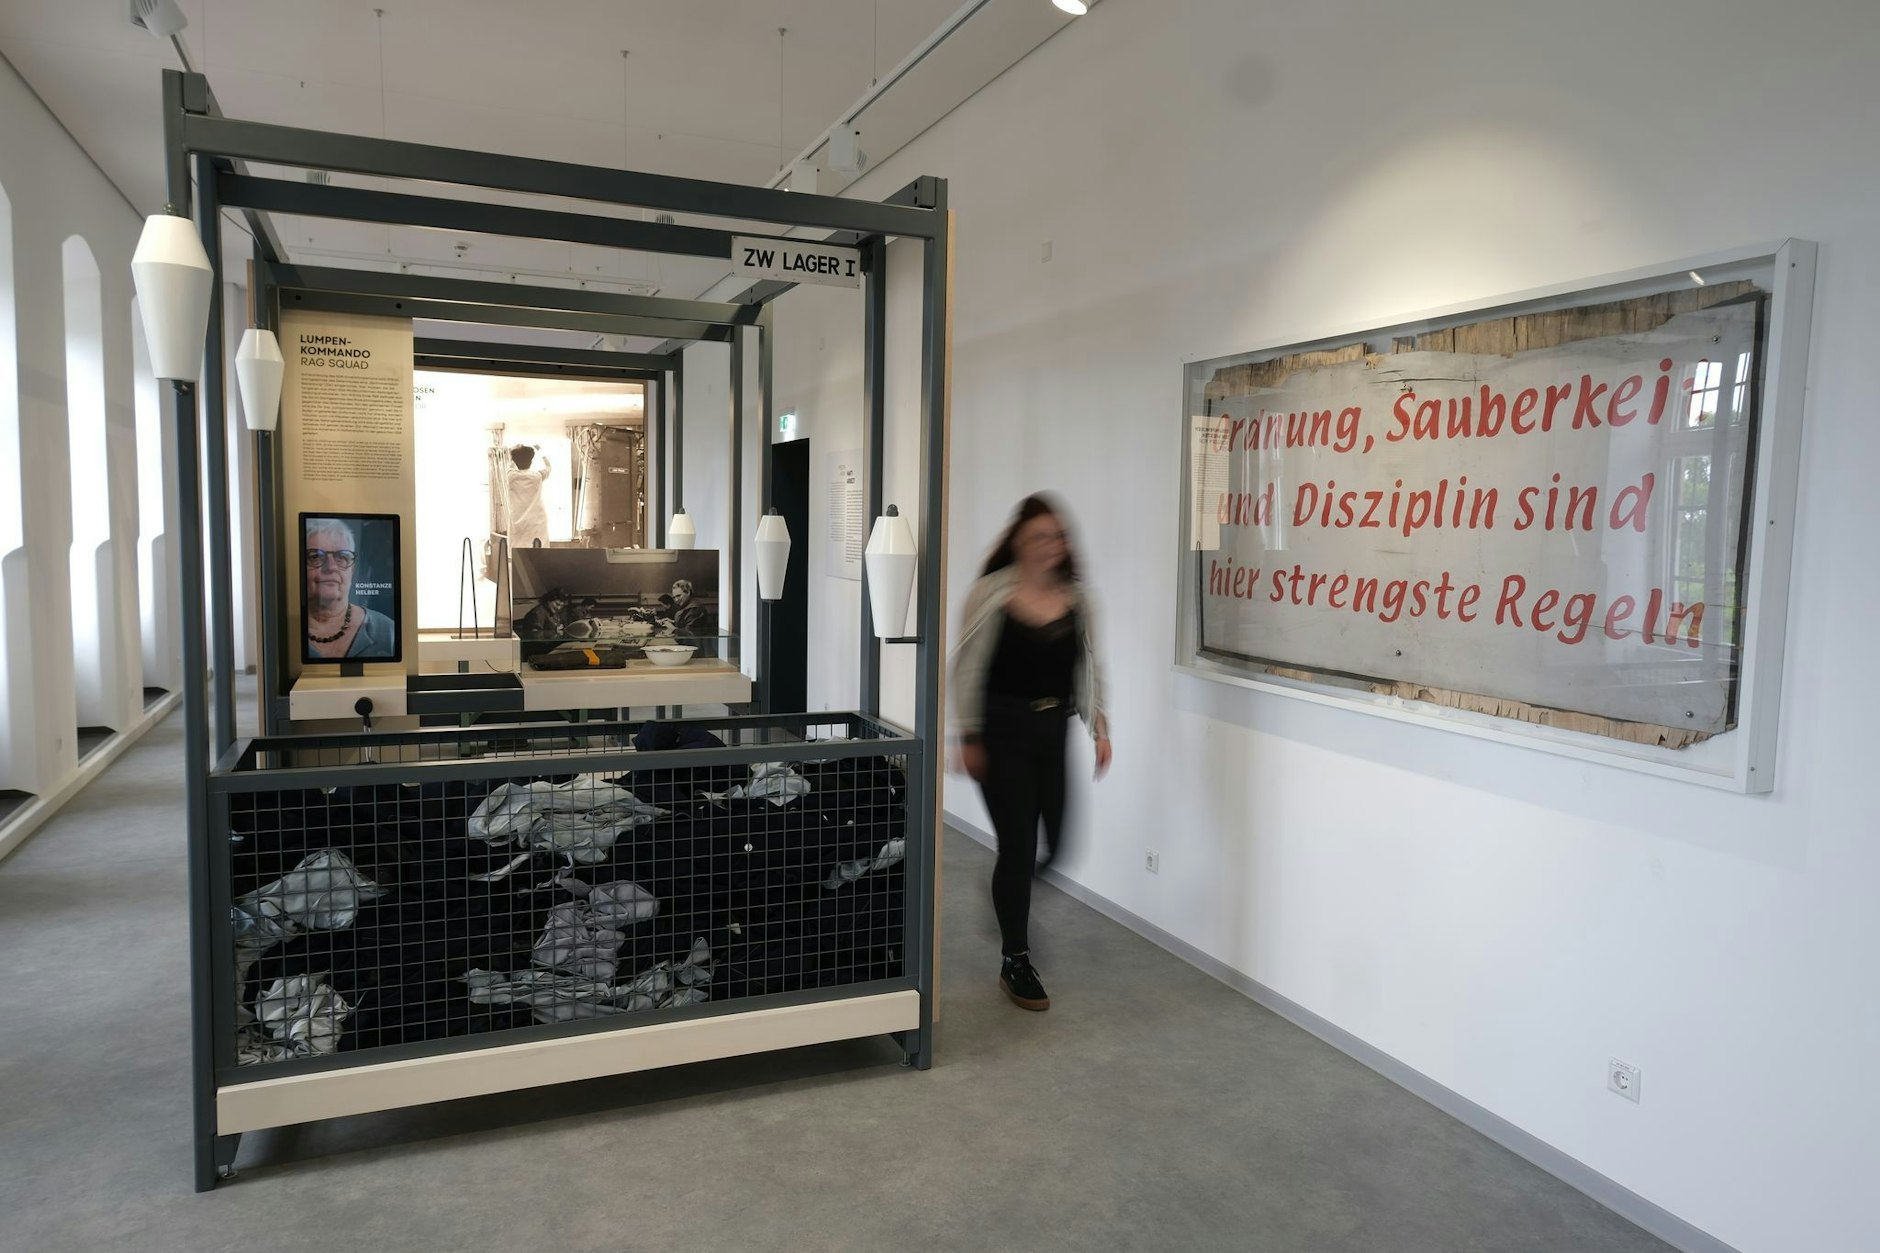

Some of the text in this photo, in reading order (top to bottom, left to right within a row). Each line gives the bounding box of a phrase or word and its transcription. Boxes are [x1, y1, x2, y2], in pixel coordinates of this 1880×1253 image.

[744, 247, 775, 269] ZW
[783, 251, 840, 276] LAGER
[300, 334, 352, 346] LUMPEN-
[300, 345, 371, 359] KOMMANDO
[300, 356, 369, 370] RAG SQUAD
[1217, 481, 1274, 528] und
[1292, 475, 1498, 538] Disziplin
[1513, 472, 1655, 533] sind
[1209, 556, 1705, 649] hier strengste Regeln
